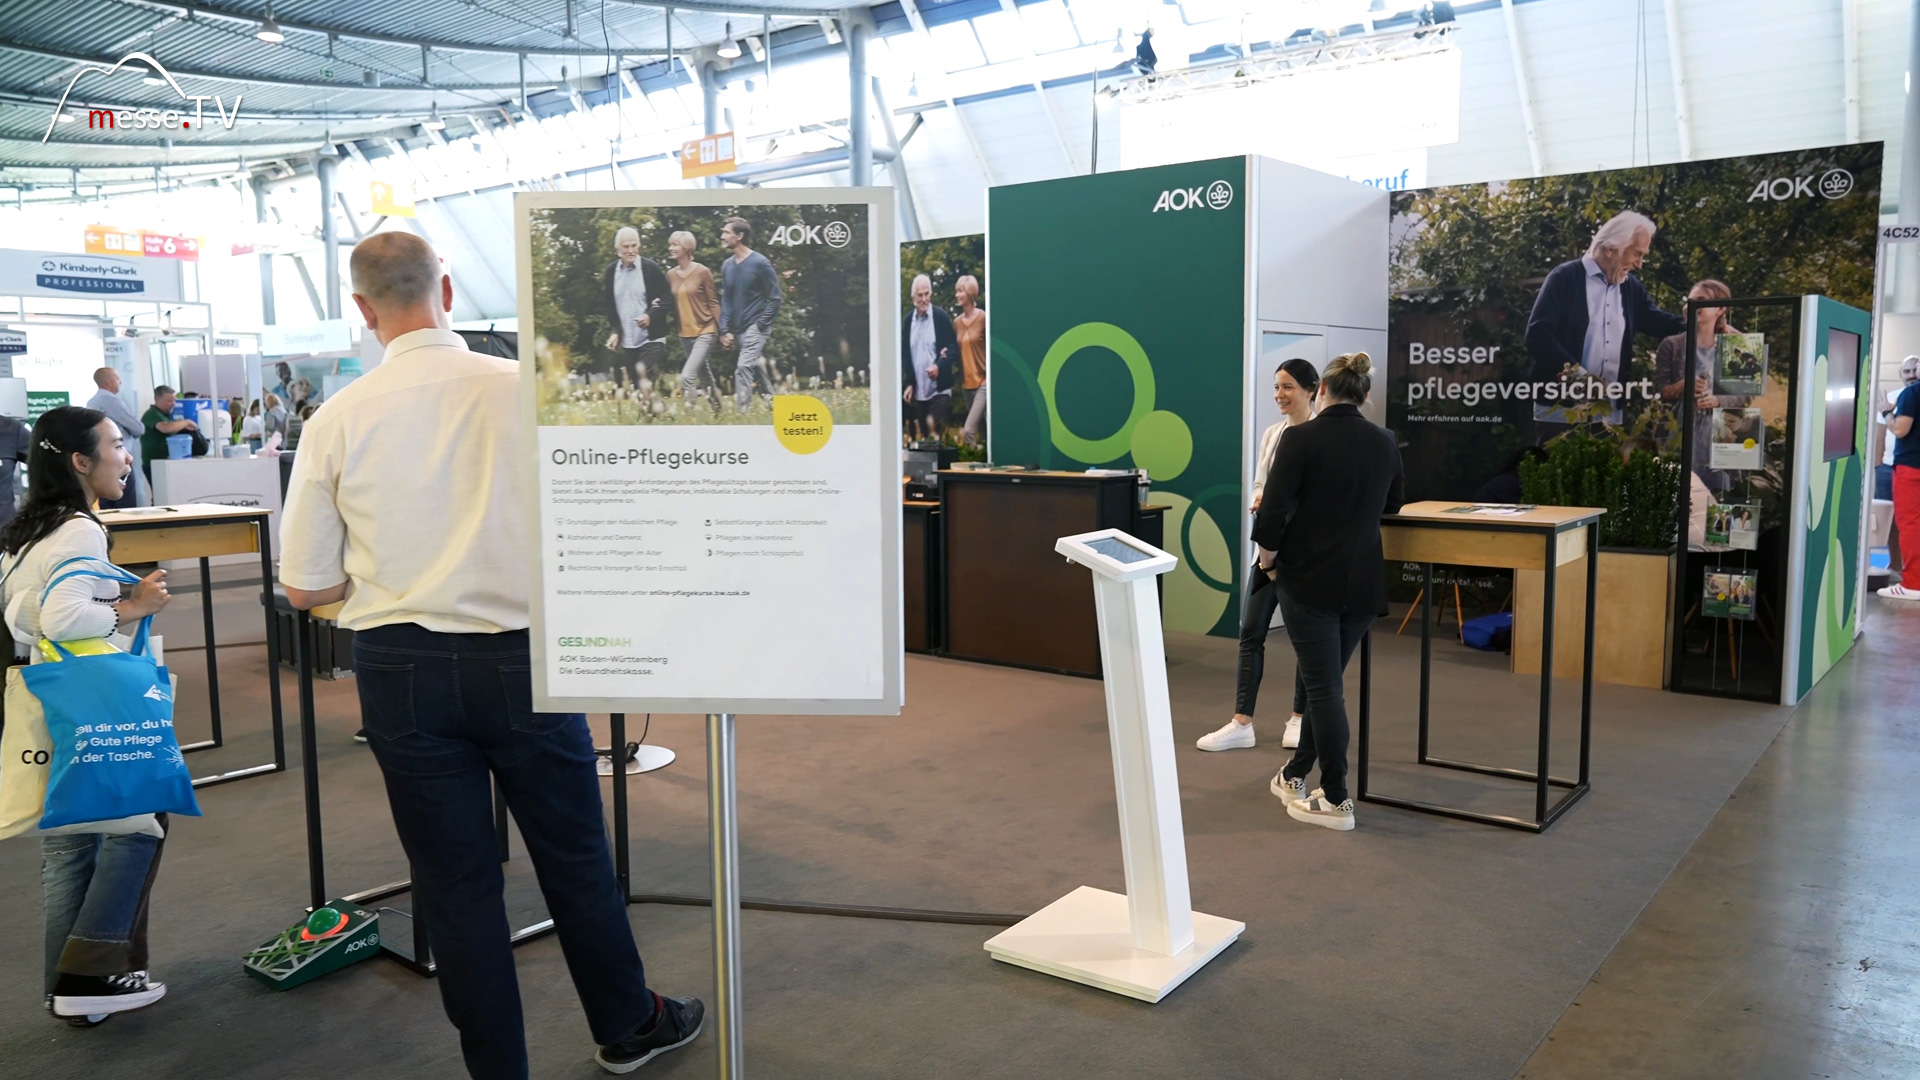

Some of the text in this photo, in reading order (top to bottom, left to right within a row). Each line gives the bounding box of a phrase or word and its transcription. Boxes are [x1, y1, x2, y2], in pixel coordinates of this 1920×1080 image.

[1747, 175, 1815, 203] AOK
[1152, 187, 1205, 213] AOK
[768, 225, 823, 247] AOK
[1883, 227, 1919, 239] 4C52
[163, 237, 177, 254] 6
[60, 262, 138, 276] Kimberly-Clark
[44, 277, 137, 290] PROFESSIONAL
[1409, 342, 1501, 365] Besser
[1408, 375, 1661, 407] pflegeversichert.
[788, 412, 818, 422] Jetzt
[1407, 414, 1502, 423] Mehr erfahren auf aok.de
[783, 426, 824, 436] testen!
[551, 448, 750, 469] Online-Pflegekurse
[1402, 574, 1416, 582] Die
[559, 655, 669, 665] AOK Baden-Württemberg
[559, 667, 654, 675] Die Gesundheitskasse.
[95, 720, 113, 732] dir
[114, 720, 140, 732] vor,
[141, 718, 159, 730] du
[90, 736, 122, 748] Gute
[124, 734, 163, 747] Pflege
[82, 751, 105, 764] der
[108, 750, 155, 763] Tasche.
[344, 937, 368, 955] AOK
